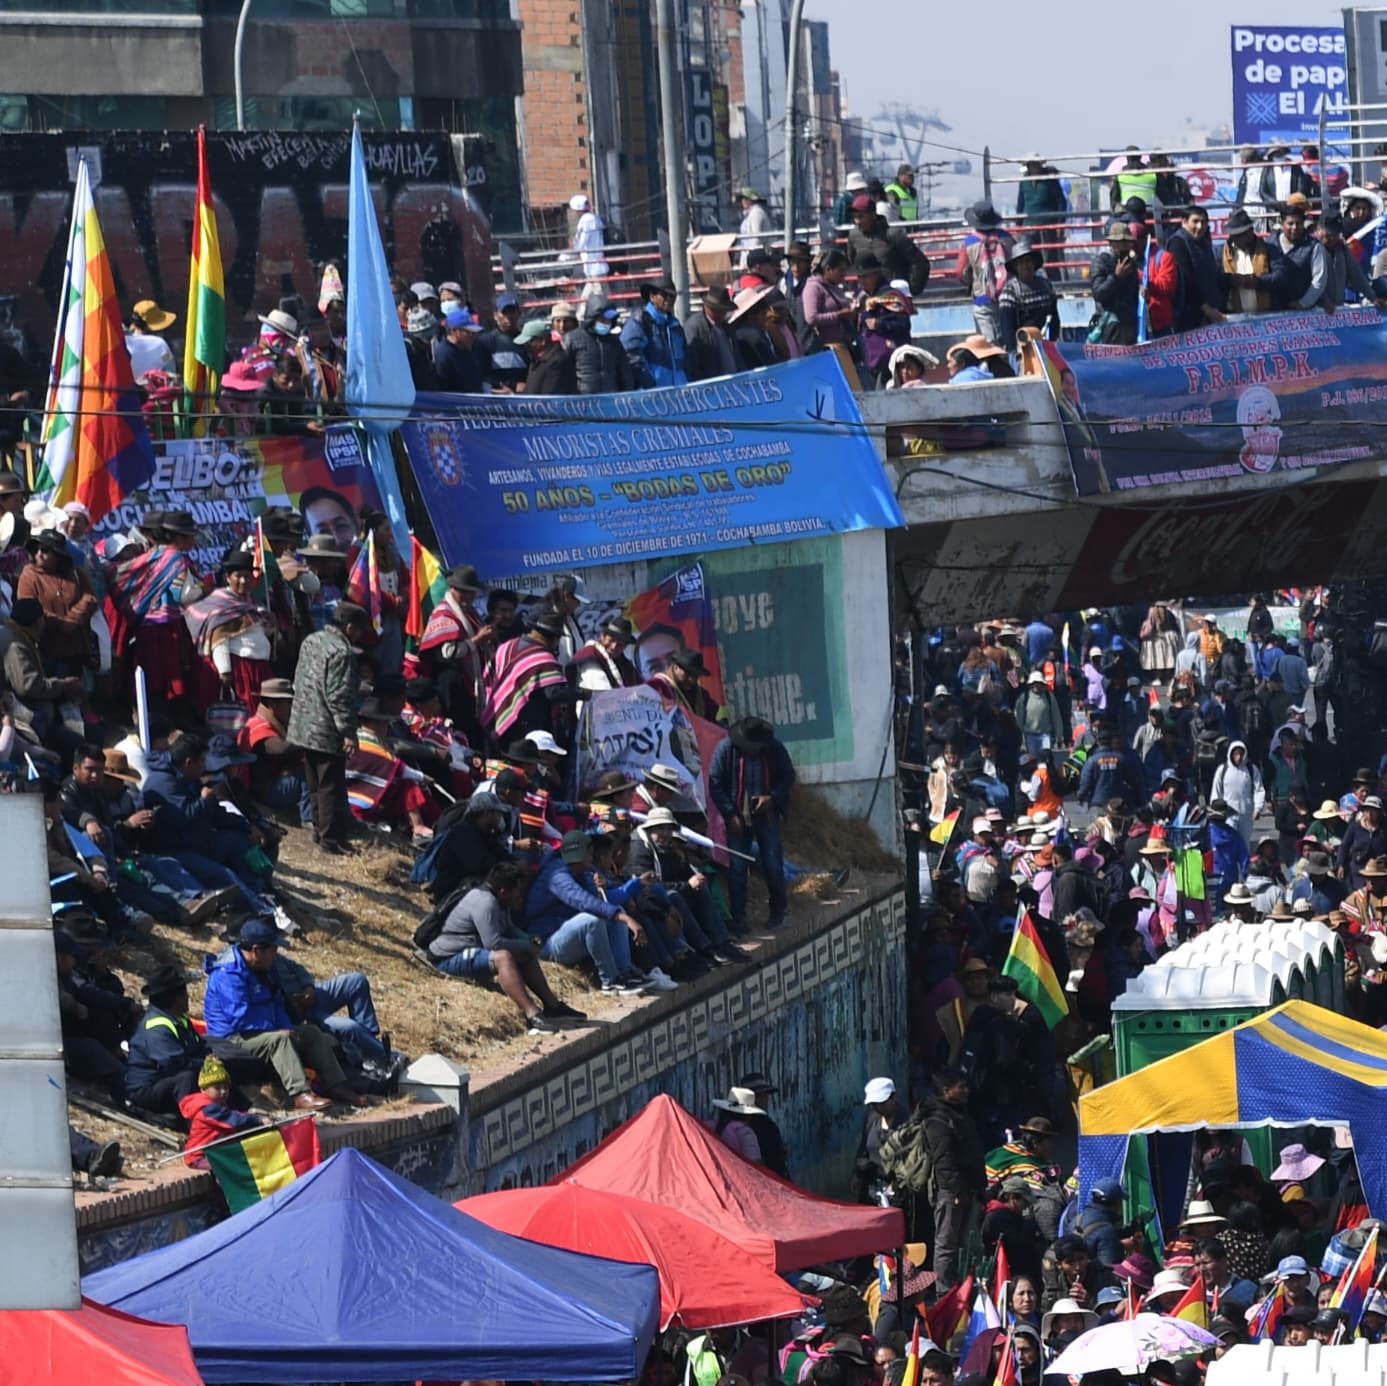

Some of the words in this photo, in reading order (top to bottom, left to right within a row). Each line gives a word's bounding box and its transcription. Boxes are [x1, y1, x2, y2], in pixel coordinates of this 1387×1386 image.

[1245, 60, 1282, 83] de
[1279, 92, 1305, 115] El
[1185, 322, 1260, 347] REGIONAL
[1263, 309, 1385, 335] INTERCULTURAL
[1168, 339, 1280, 368] PRODUCTORES
[1185, 351, 1320, 394] F.R.I.M.P.K.
[641, 377, 784, 418] COMERCIANTES
[329, 432, 355, 449] MAS
[330, 444, 360, 461] IPSP
[522, 429, 632, 463] MINORISTAS
[631, 420, 735, 454] GREMIALES
[488, 468, 537, 485] ARTESANOS,
[537, 463, 587, 481] VIVANDEROS
[613, 455, 664, 475] LEGALMENTE
[666, 450, 722, 470] ESTABLECIDAS
[723, 449, 734, 463] DE
[736, 440, 793, 462] COCHABAMBA
[502, 491, 529, 514] 50
[536, 482, 596, 513] AÑOS
[701, 469, 735, 493] DE
[523, 552, 570, 568] FUNDADA
[572, 550, 585, 563] EL
[587, 547, 598, 560] 10
[599, 546, 613, 559] DE
[615, 537, 669, 558] DICIEMBRE
[670, 535, 684, 549] DE
[686, 532, 707, 546] 1971
[717, 522, 783, 544] COCHABAMBA
